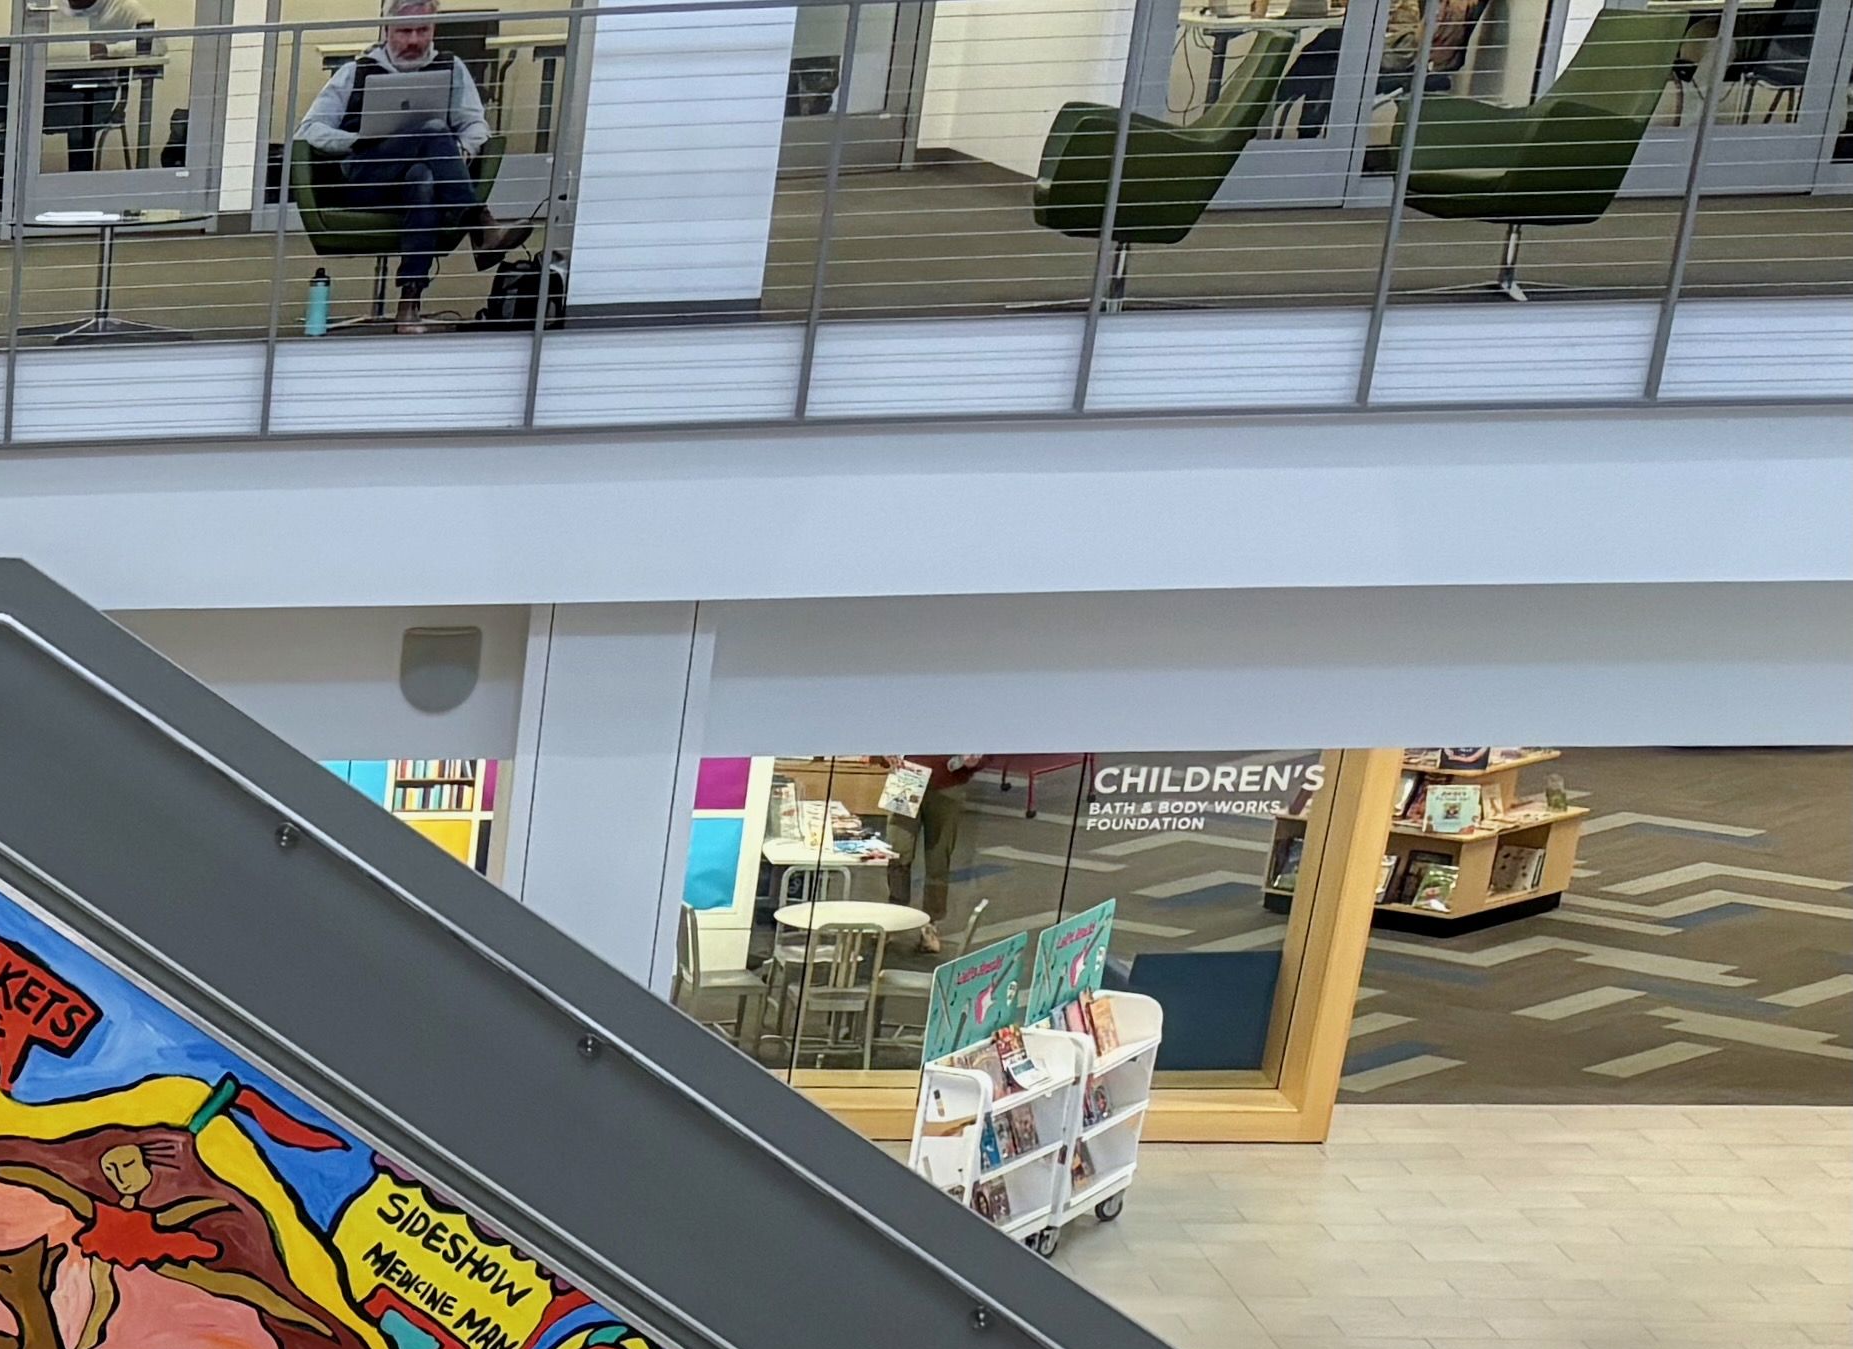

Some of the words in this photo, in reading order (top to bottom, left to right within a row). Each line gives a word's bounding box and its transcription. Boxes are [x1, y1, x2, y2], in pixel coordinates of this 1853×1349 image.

[1094, 764, 1325, 793] CHILDREN'S
[1089, 801, 1136, 815] BATH
[1140, 801, 1153, 815] &
[1157, 800, 1208, 814] BODY
[1214, 800, 1280, 814] WORKS
[1086, 817, 1205, 831] FOUNDATION
[376, 1192, 534, 1308] SIDESHOW
[362, 1241, 459, 1317] MEDICINE
